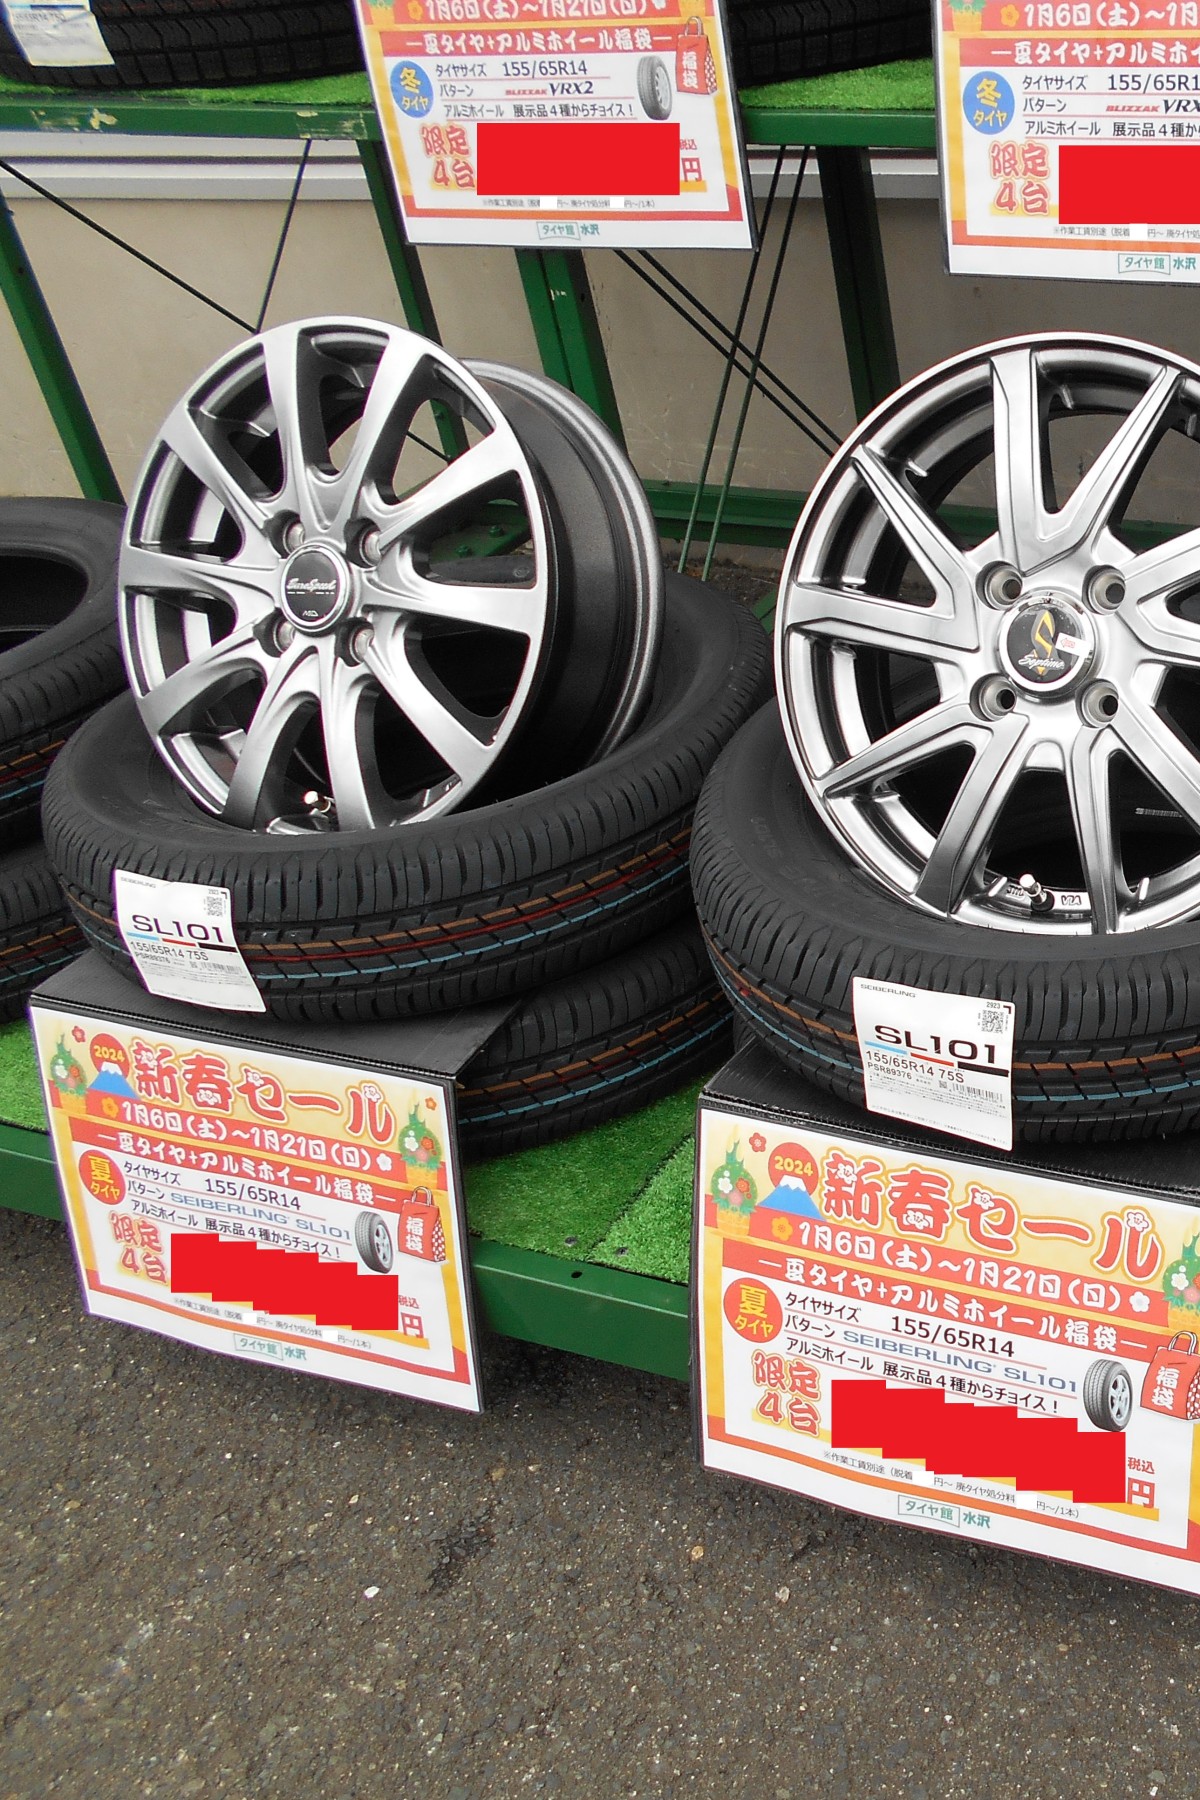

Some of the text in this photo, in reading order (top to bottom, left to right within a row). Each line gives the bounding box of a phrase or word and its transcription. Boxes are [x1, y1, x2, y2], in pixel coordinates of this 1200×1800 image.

[400, 68, 420, 94] 冬
[437, 61, 587, 78] タイヤサイズ 155/65R14
[1023, 74, 1088, 91] タイヤサイズ
[440, 85, 473, 97] パターン
[549, 82, 593, 96] VRX2
[976, 78, 1001, 107] 冬
[402, 97, 428, 110] タイヤ
[445, 104, 504, 117] アルミホイール
[1023, 98, 1067, 113] パターン
[1106, 105, 1160, 113] BLIZZAK
[974, 110, 1007, 127] タイヤ
[1025, 121, 1100, 136] アルミホイール
[421, 126, 470, 155] 限定
[682, 158, 701, 182] 円
[992, 142, 1048, 177] 限定
[434, 159, 475, 188] 4台
[997, 182, 1048, 214] 4台
[580, 224, 599, 235] 水沢
[1125, 258, 1196, 269] タイヤ館 水沢
[132, 915, 223, 943] SL101
[131, 942, 184, 958] 155/65R14
[187, 950, 208, 961] 75S
[861, 984, 916, 998] SEIBERLING
[94, 1045, 124, 1062] 2024
[875, 1025, 995, 1064] SL101
[866, 1051, 964, 1083] 155/65R14 75S
[133, 1040, 395, 1144] 新春セール
[91, 1157, 110, 1184] 夏
[774, 1156, 813, 1177] 2024
[91, 1183, 120, 1199] タイヤ
[124, 1162, 301, 1210] タイヤサイズ 155/65R14
[127, 1181, 351, 1241] パターン SEIBERLING SL101
[131, 1200, 198, 1227] アルミホイール
[822, 1151, 1162, 1280] 新春セール
[110, 1213, 162, 1253] 限定
[123, 1250, 169, 1284] 4台
[739, 1286, 767, 1316] 夏
[402, 1313, 424, 1339] 円
[735, 1315, 773, 1336] タイヤ
[786, 1292, 1014, 1357] タイヤサイズ 155/65R14
[284, 1347, 306, 1361] 水沢
[785, 1318, 1076, 1392] パターン SEIBERLING SL101
[786, 1338, 872, 1371] アルミホイール
[753, 1352, 820, 1397] 限定
[759, 1395, 820, 1435] 4台
[1127, 1478, 1155, 1508] 円
[905, 1501, 990, 1529] タイヤ館 水沢
